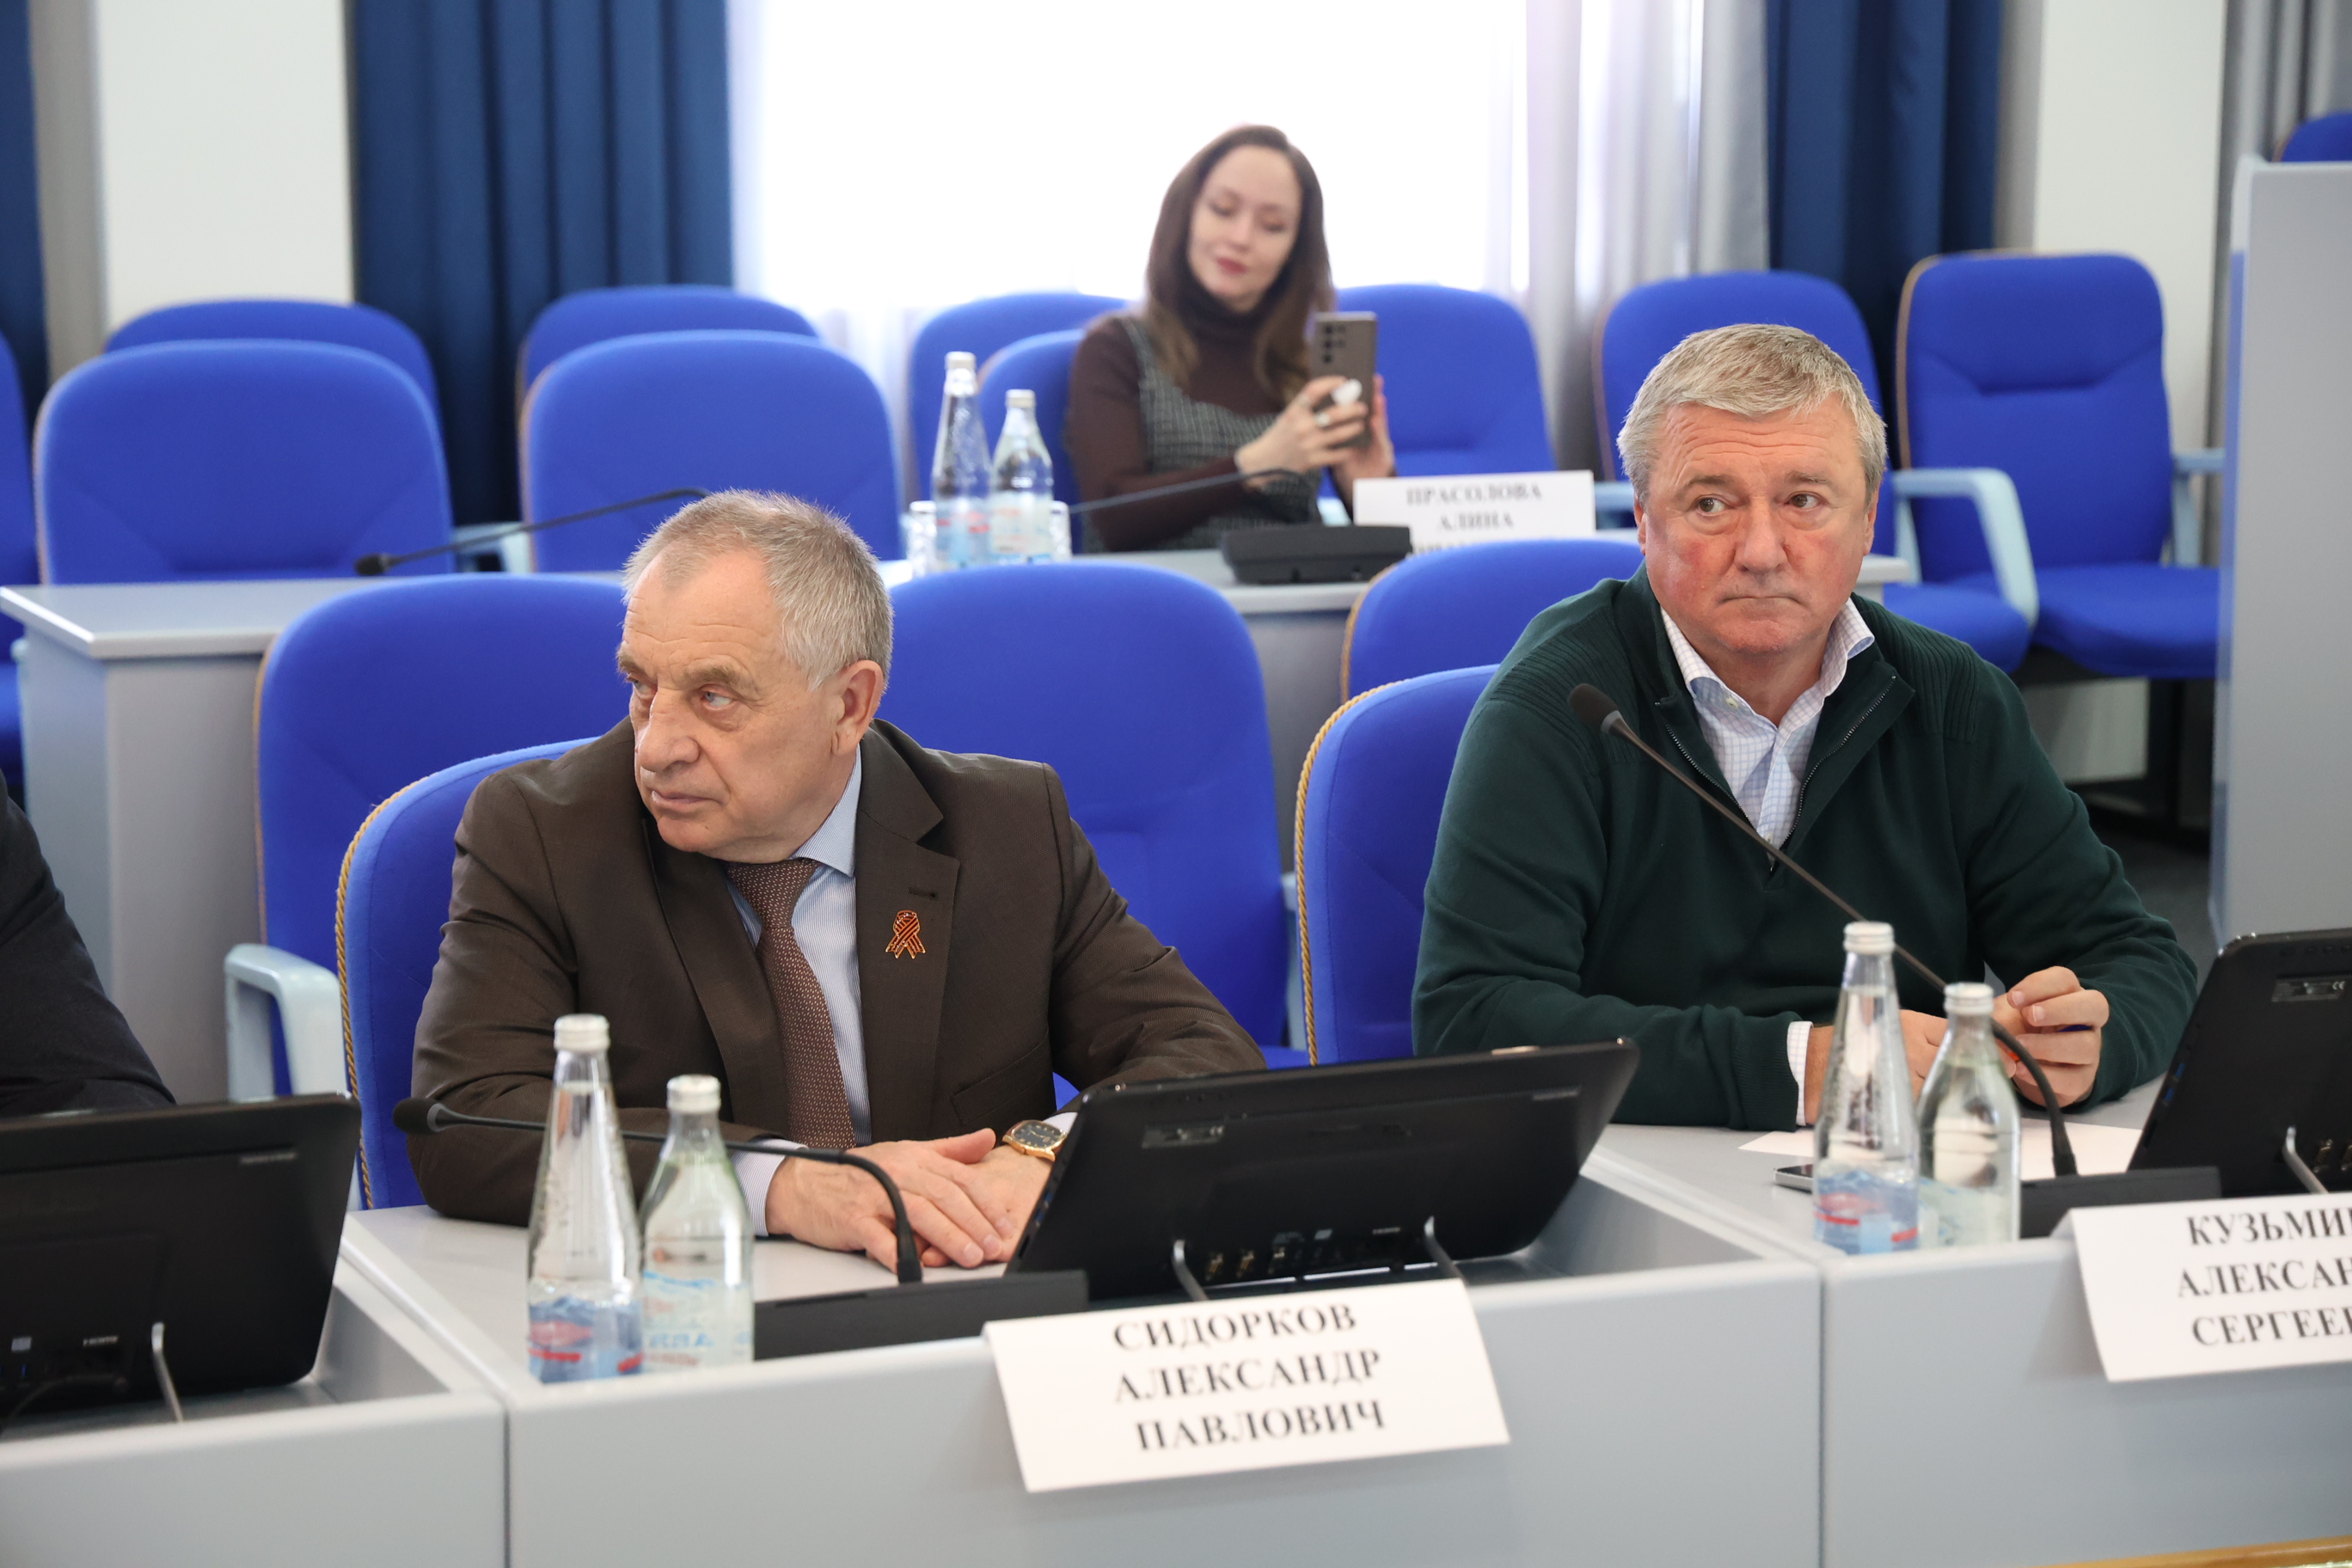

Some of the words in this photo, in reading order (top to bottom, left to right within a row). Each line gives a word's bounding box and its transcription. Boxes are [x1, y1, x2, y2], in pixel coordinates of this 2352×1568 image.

[2186, 1206, 2352, 1246] КУЗЬМИ
[1113, 1304, 1357, 1351] СИДОРКОВ
[1114, 1349, 1381, 1403] АЛЕКСАНДР
[1136, 1399, 1385, 1451] ПАВЛОВИЧ
